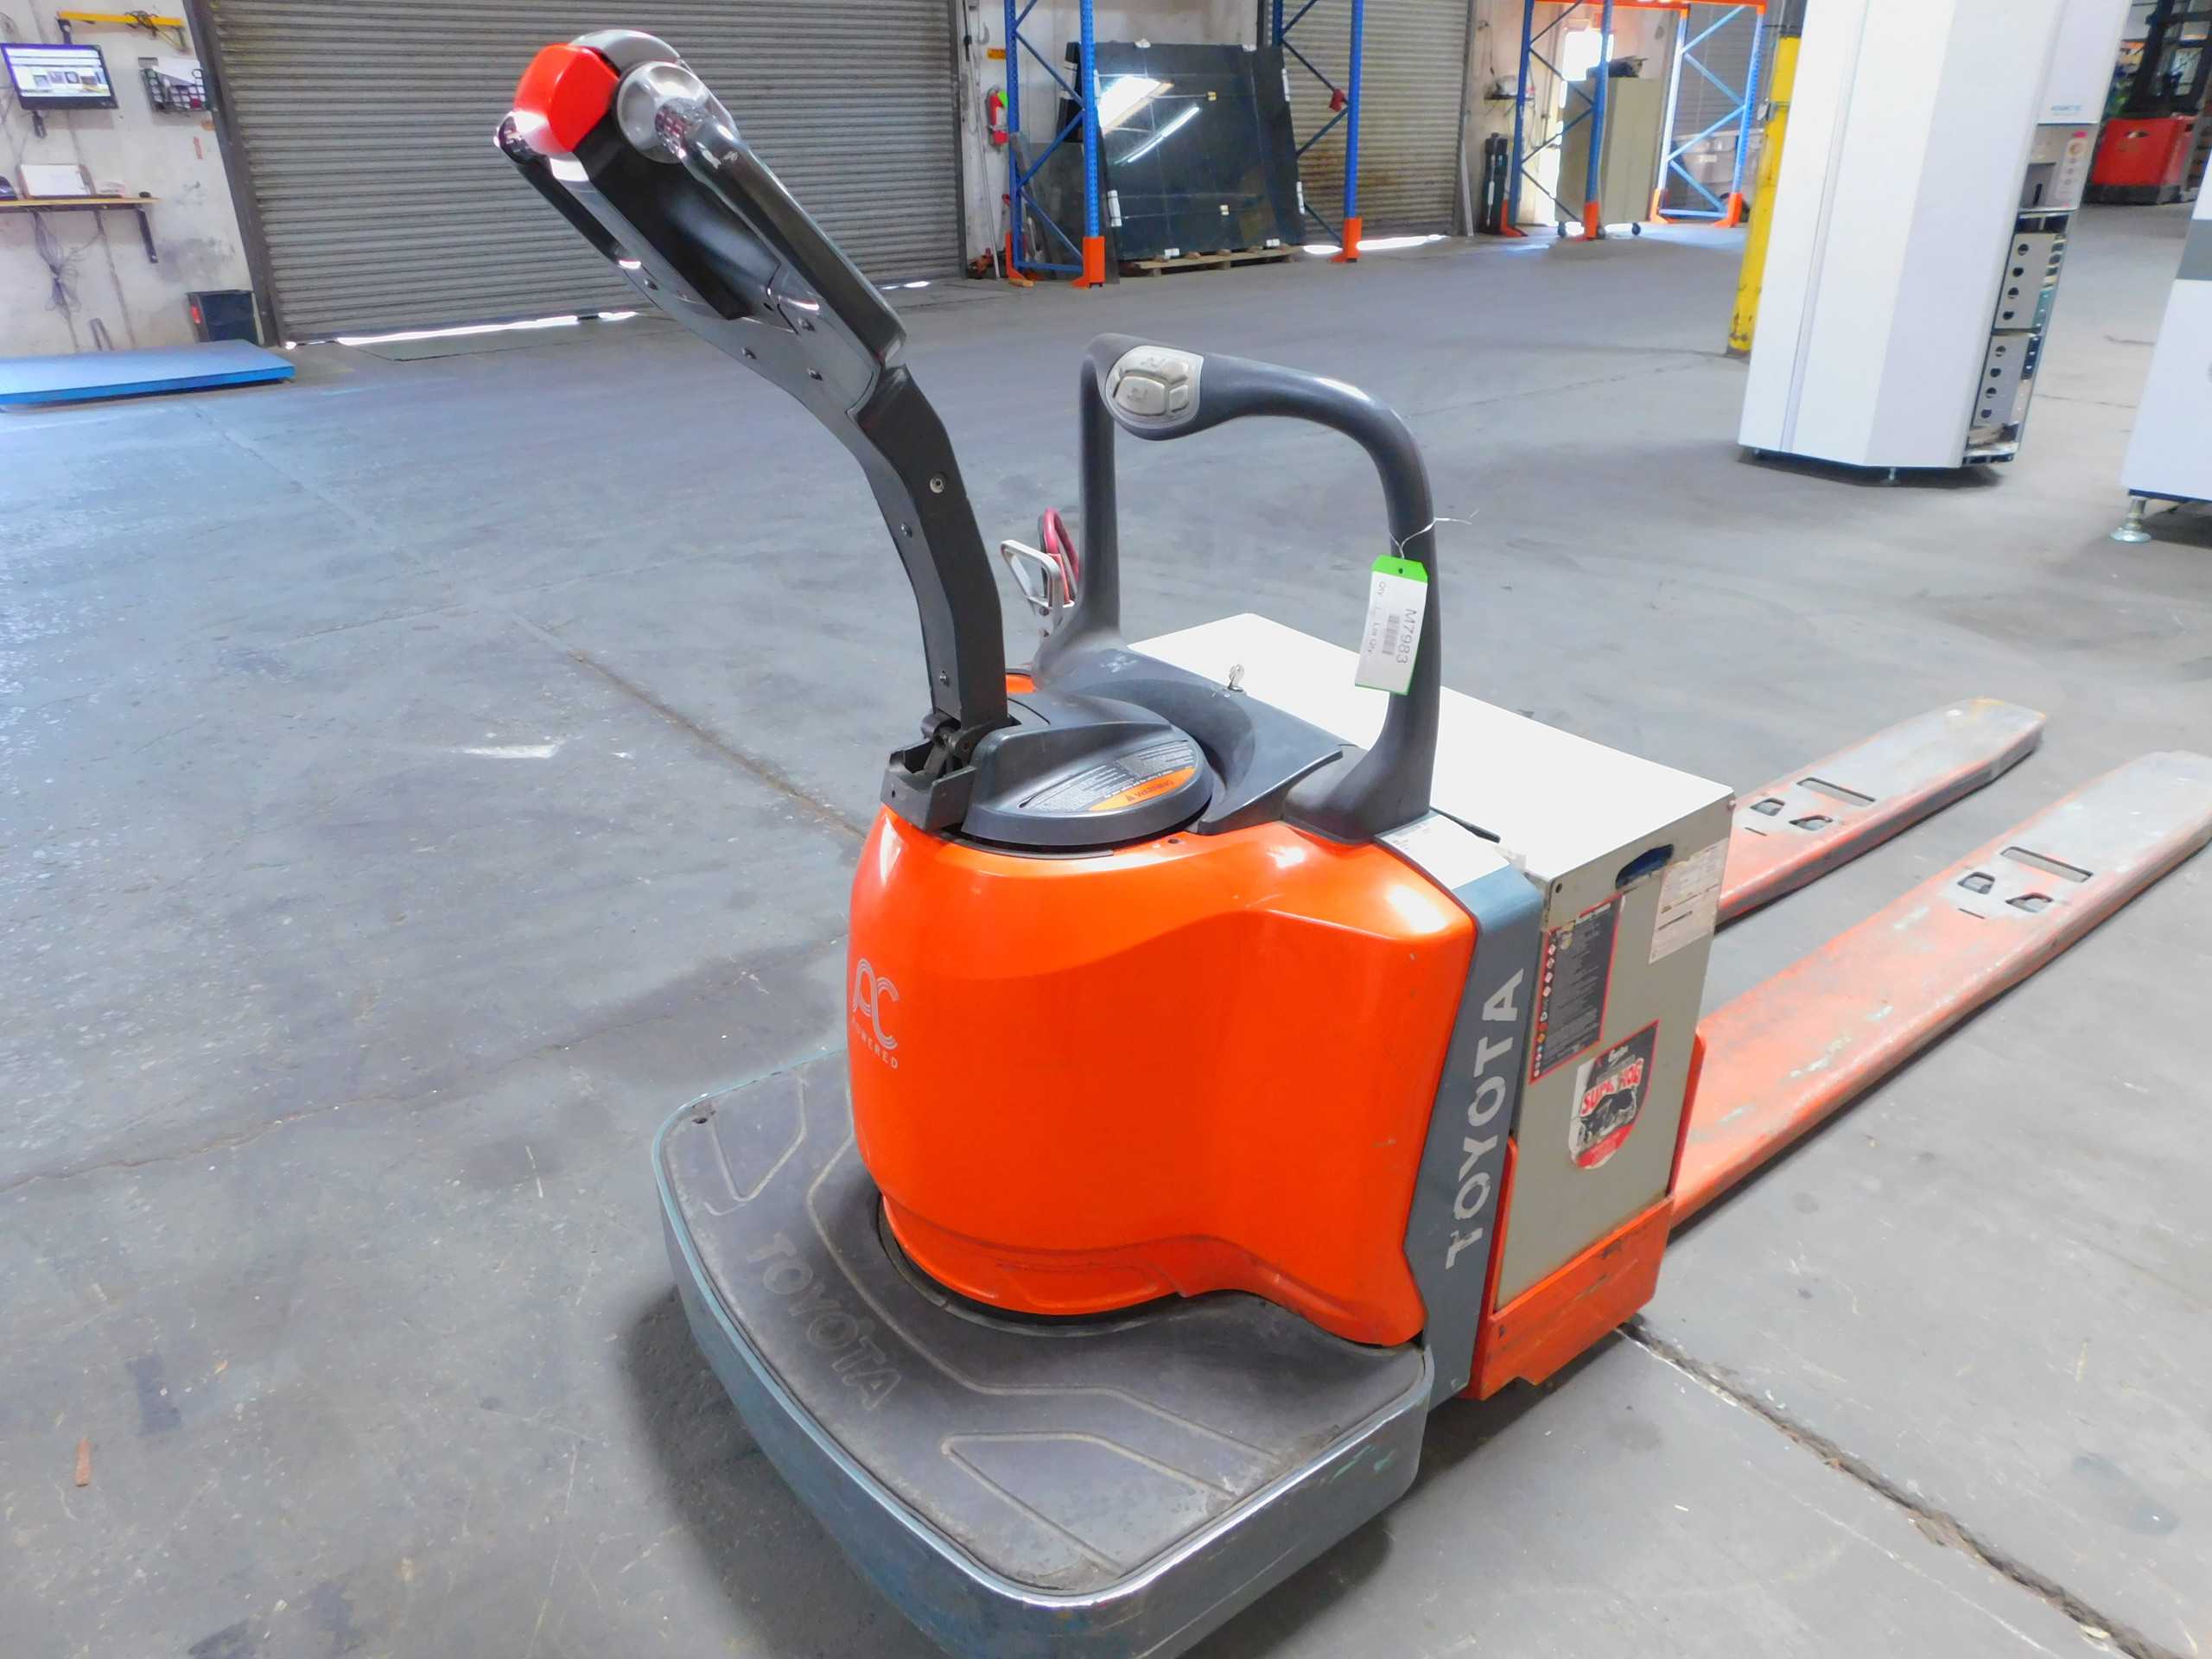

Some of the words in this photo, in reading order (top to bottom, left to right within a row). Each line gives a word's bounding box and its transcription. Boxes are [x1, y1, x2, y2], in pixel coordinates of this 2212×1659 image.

[1396, 608, 1417, 664] M7983
[852, 957, 899, 1051] AC
[1445, 967, 1524, 1270] TOYOTA
[746, 1232, 901, 1412] TOYOTA
